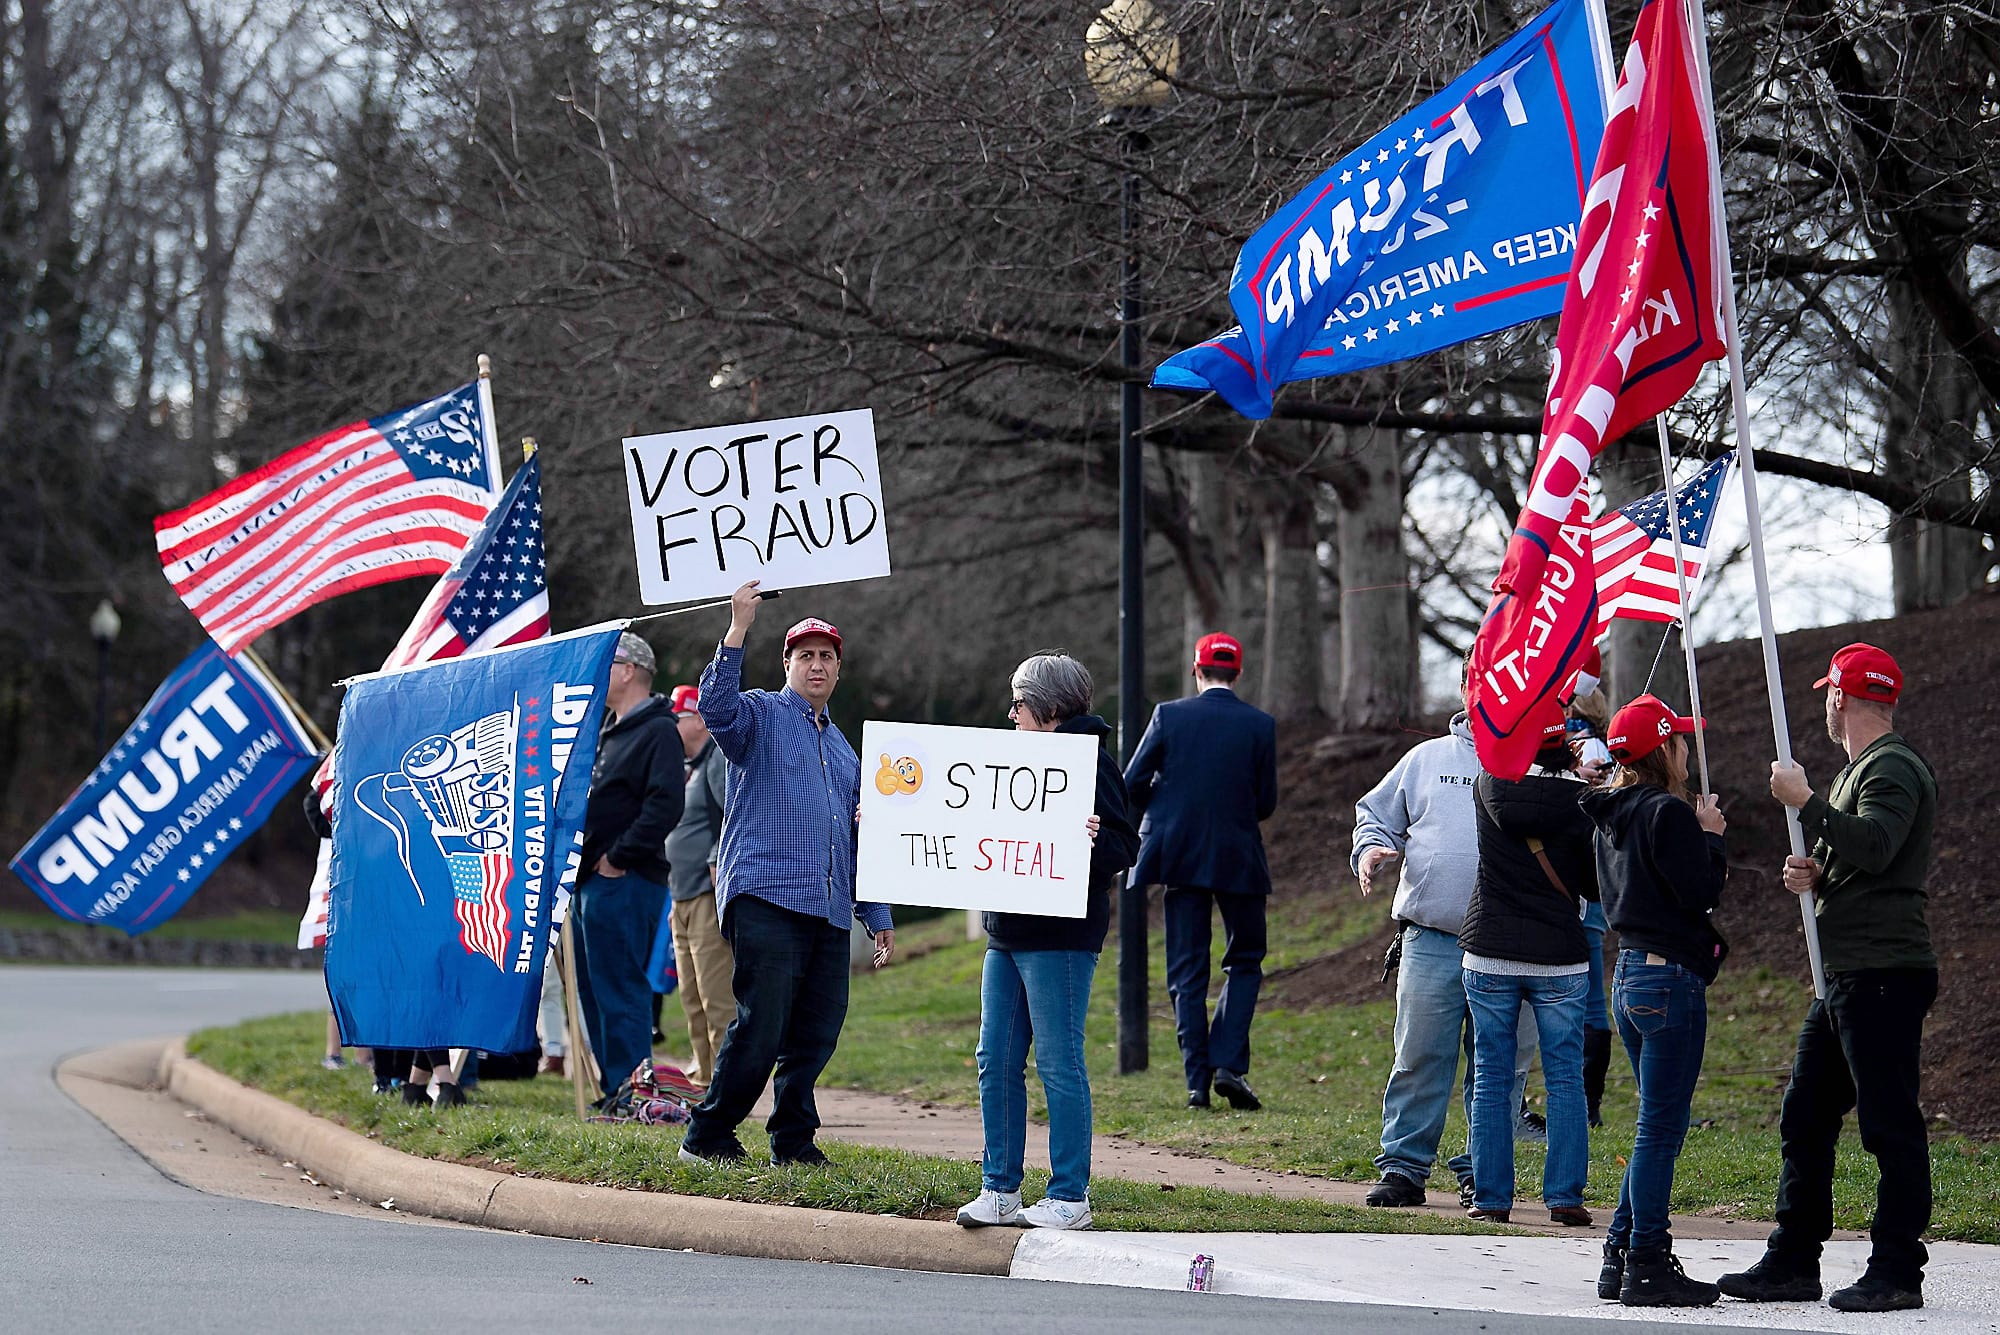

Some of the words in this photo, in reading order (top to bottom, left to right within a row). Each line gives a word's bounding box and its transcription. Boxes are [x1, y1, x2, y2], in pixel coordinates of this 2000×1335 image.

[630, 424, 864, 507] VOTER
[656, 493, 877, 581] FRAUD
[1657, 717, 1671, 736] 45
[945, 763, 1068, 812] STOP
[1440, 775, 1459, 785] WE
[901, 833, 957, 870] THE
[974, 838, 1064, 880] STEAL
